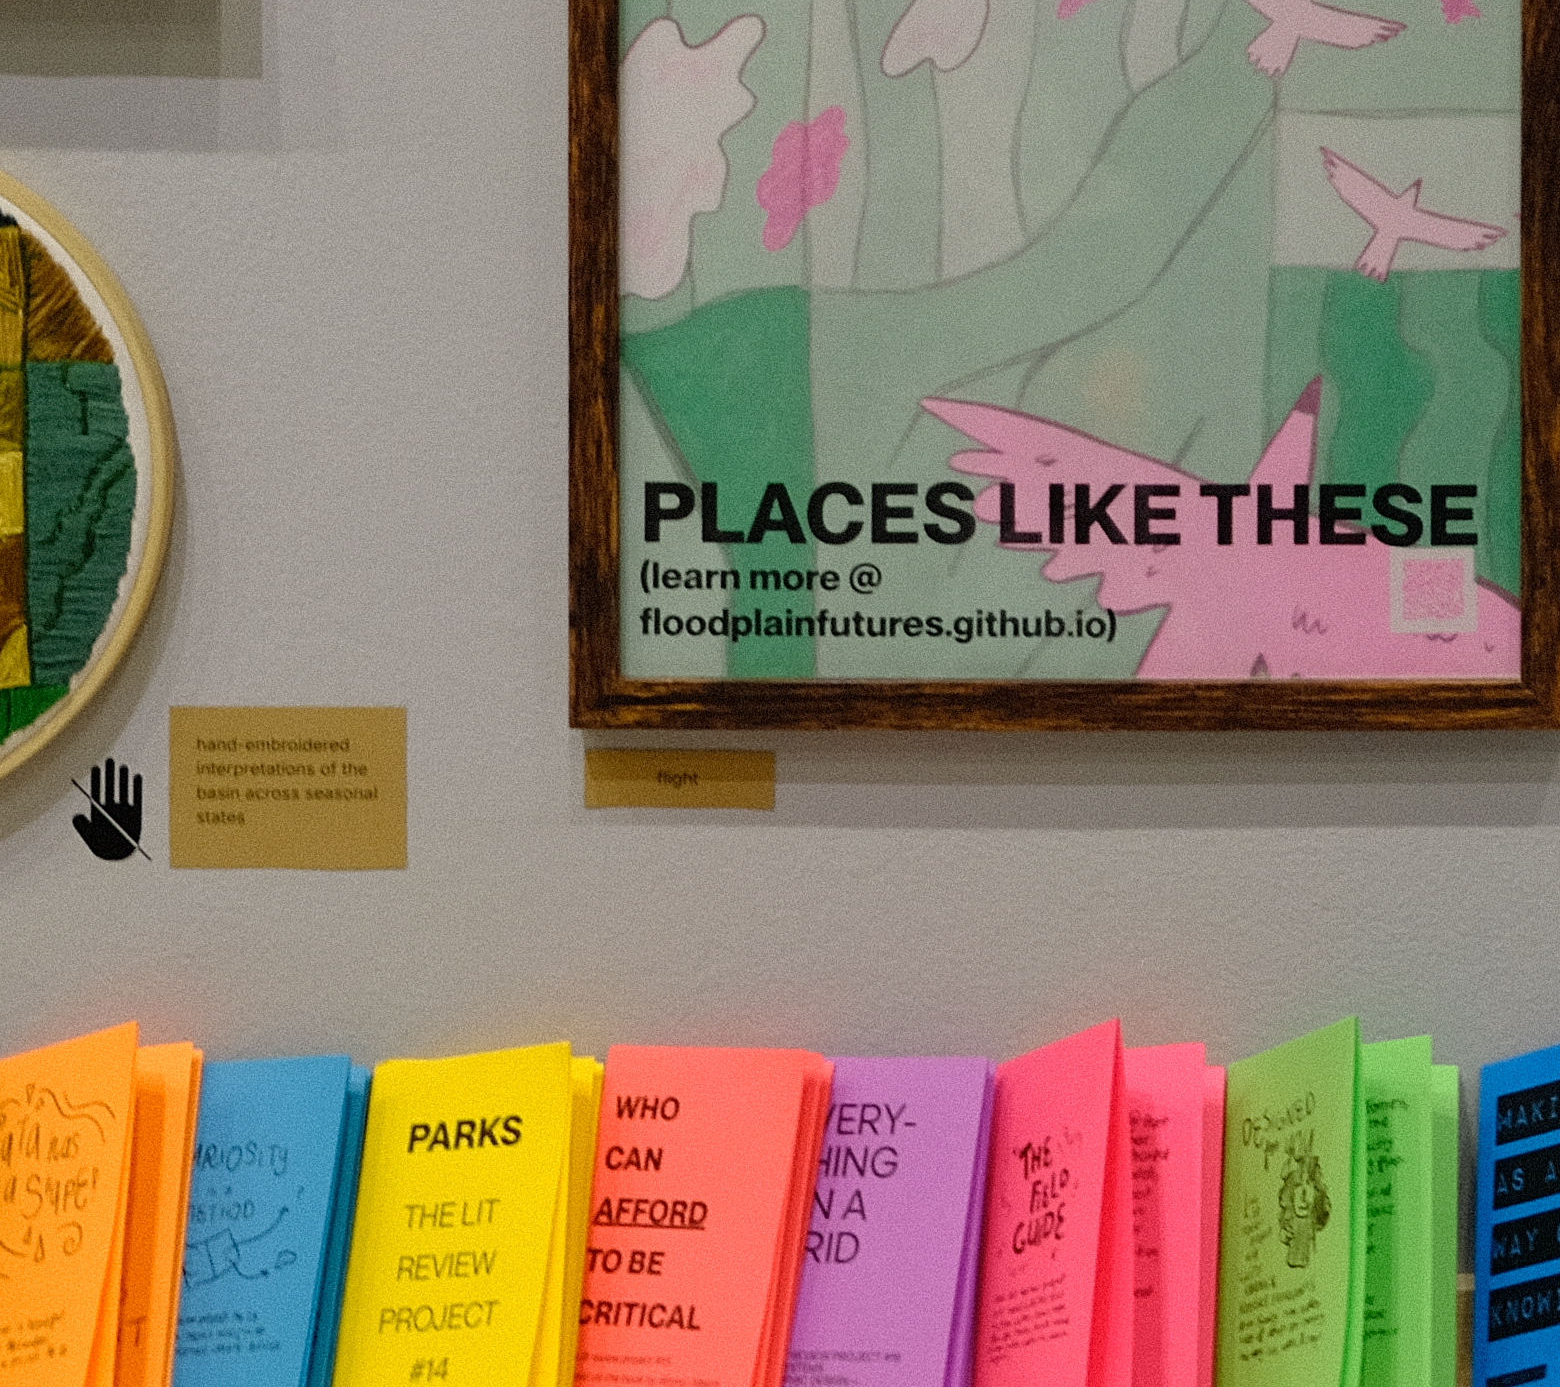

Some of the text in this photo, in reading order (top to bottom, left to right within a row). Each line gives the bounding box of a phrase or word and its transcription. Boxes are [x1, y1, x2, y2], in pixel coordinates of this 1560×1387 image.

[642, 481, 1478, 547] PLACES LIKE THESE
[640, 561, 882, 595] (learn more @
[640, 608, 1118, 642] floodplainfutures.github.io)
[340, 762, 368, 775] the
[656, 769, 699, 789] flight
[615, 1095, 680, 1122] WHO
[407, 1115, 523, 1154] PARKS
[605, 1146, 663, 1172] CAN
[404, 1199, 500, 1228] THE LIT
[594, 1198, 708, 1228] AFFORD
[397, 1250, 497, 1281] REVIEW
[587, 1249, 665, 1276] TO BE
[379, 1301, 500, 1333] PROJECT
[577, 1299, 701, 1331] CRITICAL
[410, 1356, 449, 1382] #14
